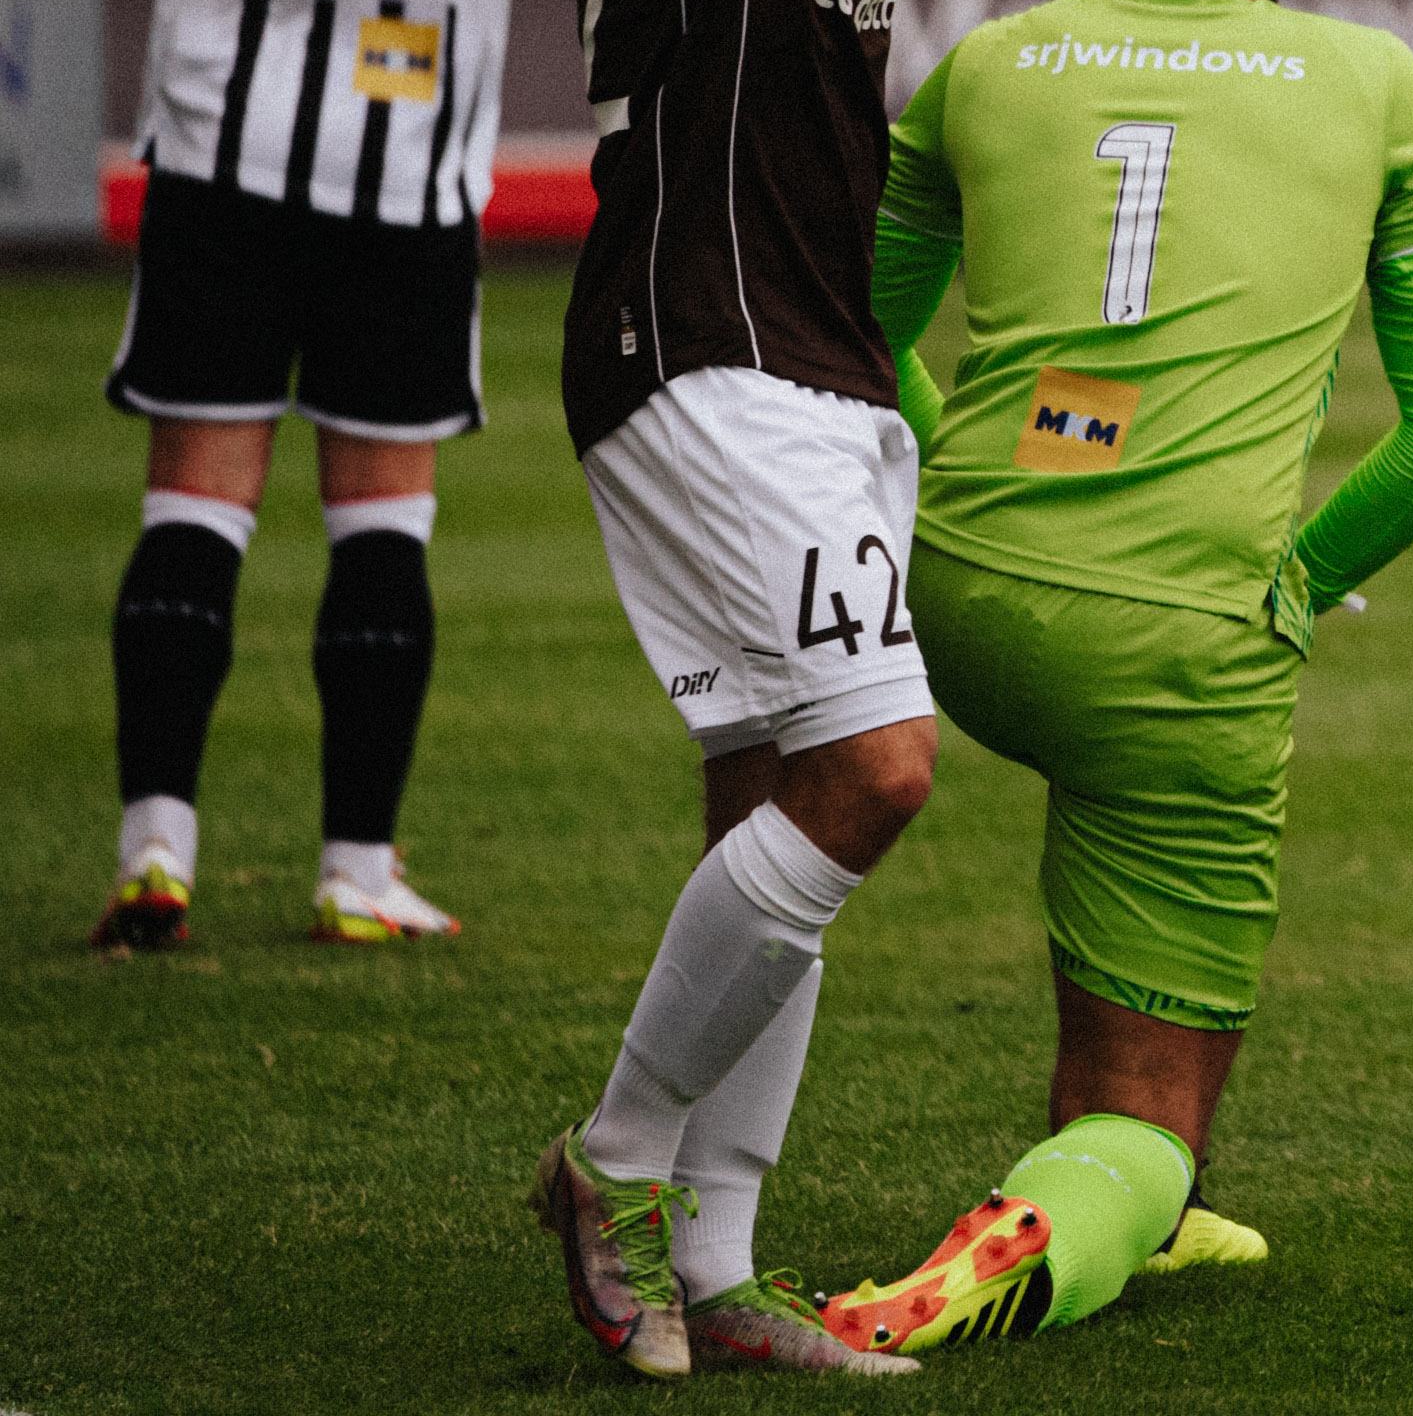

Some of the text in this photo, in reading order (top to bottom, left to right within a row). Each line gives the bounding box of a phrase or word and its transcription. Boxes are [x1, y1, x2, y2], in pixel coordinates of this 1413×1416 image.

[1015, 34, 1306, 81] srjwindows
[1095, 122, 1177, 326] 1
[1034, 405, 1120, 447] MKM
[797, 534, 914, 656] 42
